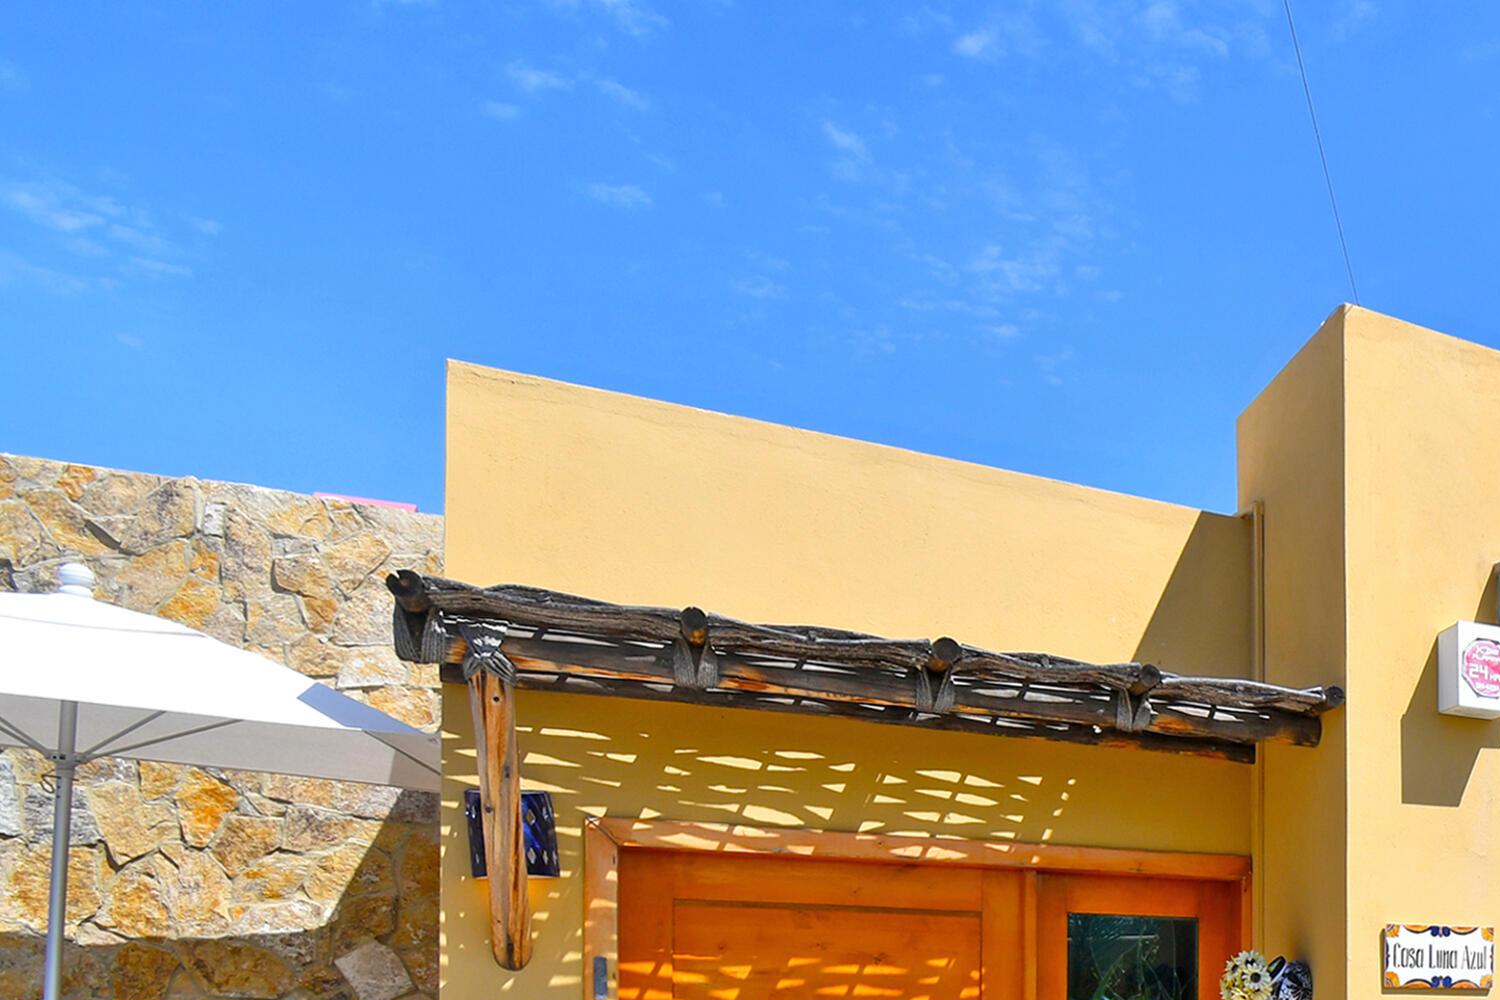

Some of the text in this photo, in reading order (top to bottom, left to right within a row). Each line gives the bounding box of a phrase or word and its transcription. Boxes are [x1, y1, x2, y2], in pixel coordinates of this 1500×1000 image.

[1469, 663, 1488, 680] 24
[1393, 942, 1487, 970] Casa Luna Azul
